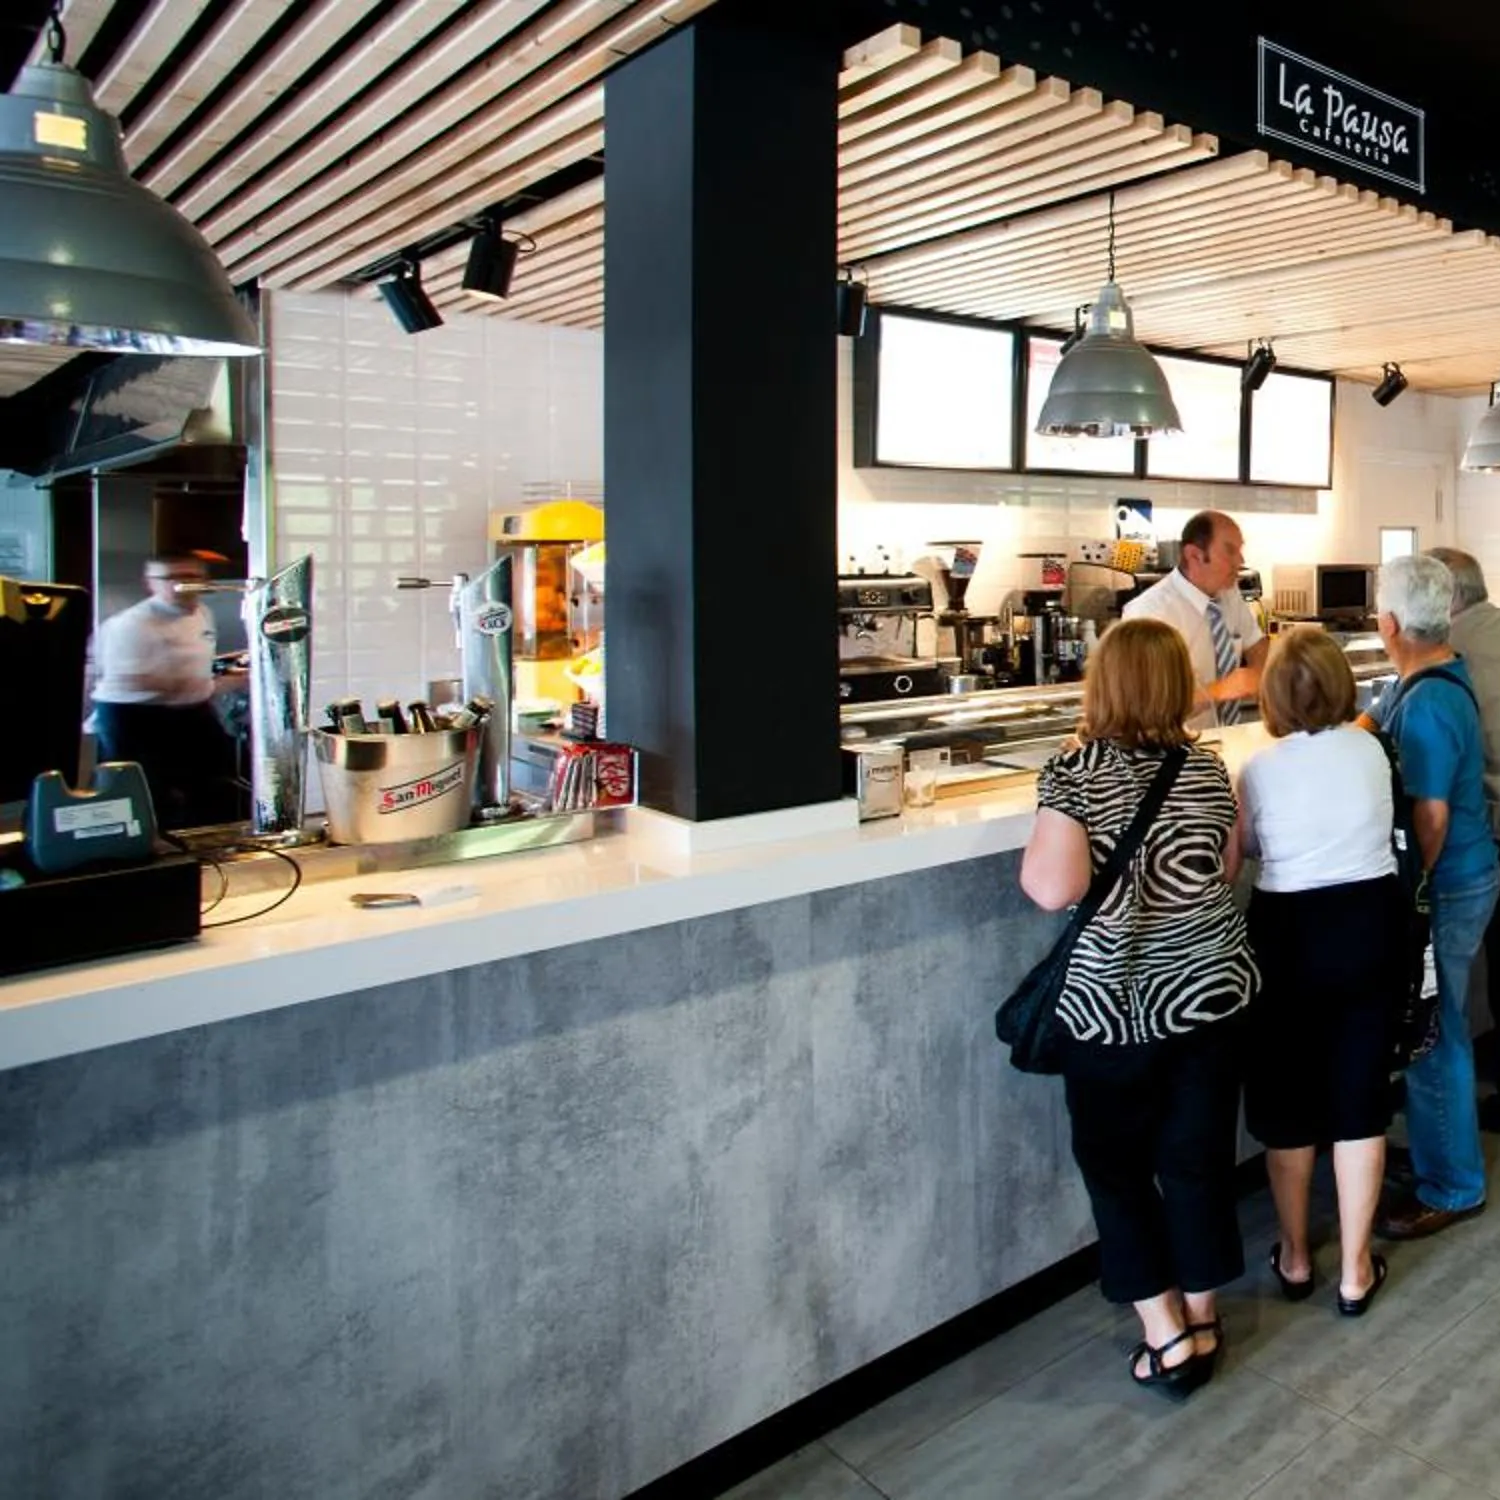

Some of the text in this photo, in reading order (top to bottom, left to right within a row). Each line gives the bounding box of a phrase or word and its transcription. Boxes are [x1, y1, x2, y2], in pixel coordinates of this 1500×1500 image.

[1279, 62, 1410, 154] La Pausa
[382, 789, 415, 809] San
